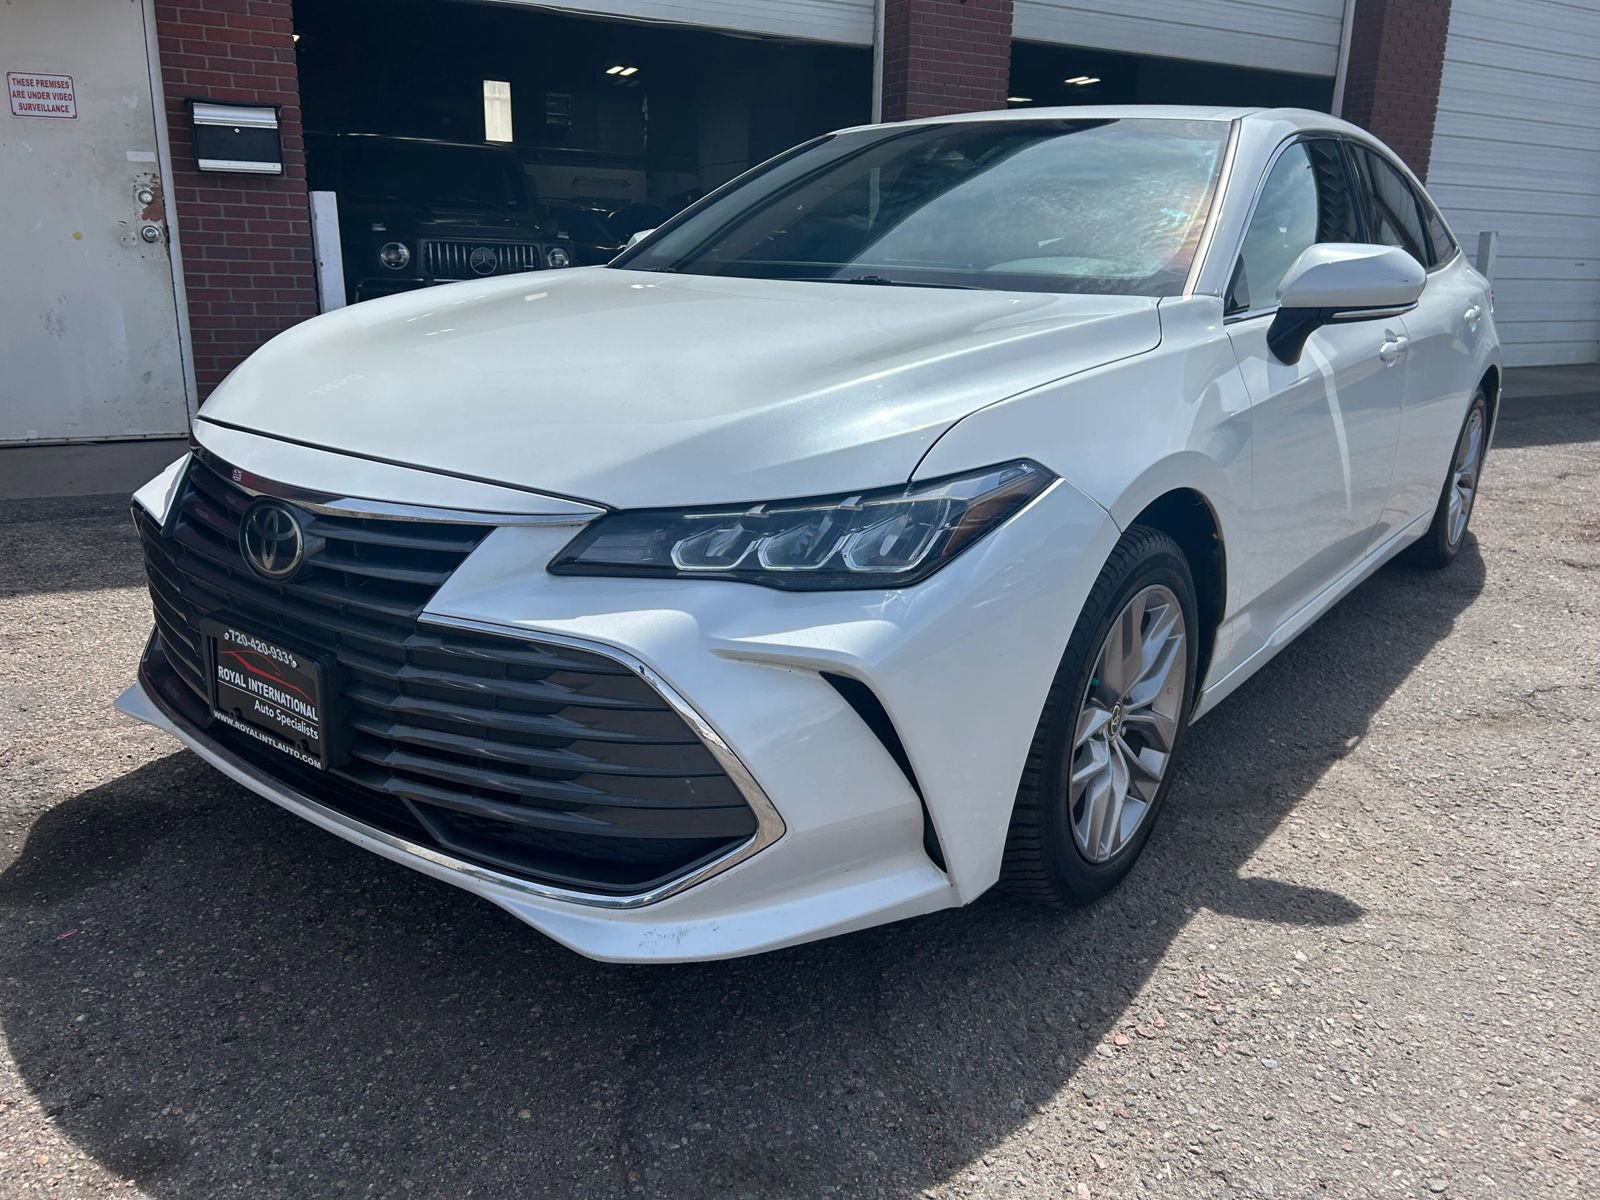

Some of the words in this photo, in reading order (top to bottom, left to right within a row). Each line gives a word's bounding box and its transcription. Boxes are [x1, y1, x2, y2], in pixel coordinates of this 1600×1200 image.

[11, 77, 34, 87] THESE
[35, 79, 70, 89] PREMISES
[12, 90, 26, 99] ARE
[27, 91, 51, 100] UNDER
[52, 92, 73, 101] VIDEO
[18, 102, 70, 113] SURVEILLANCE
[218, 665, 247, 688] ROYAL
[248, 677, 319, 721] INTERNATIONAL
[254, 699, 275, 718] Auto
[276, 709, 319, 740] Specialists
